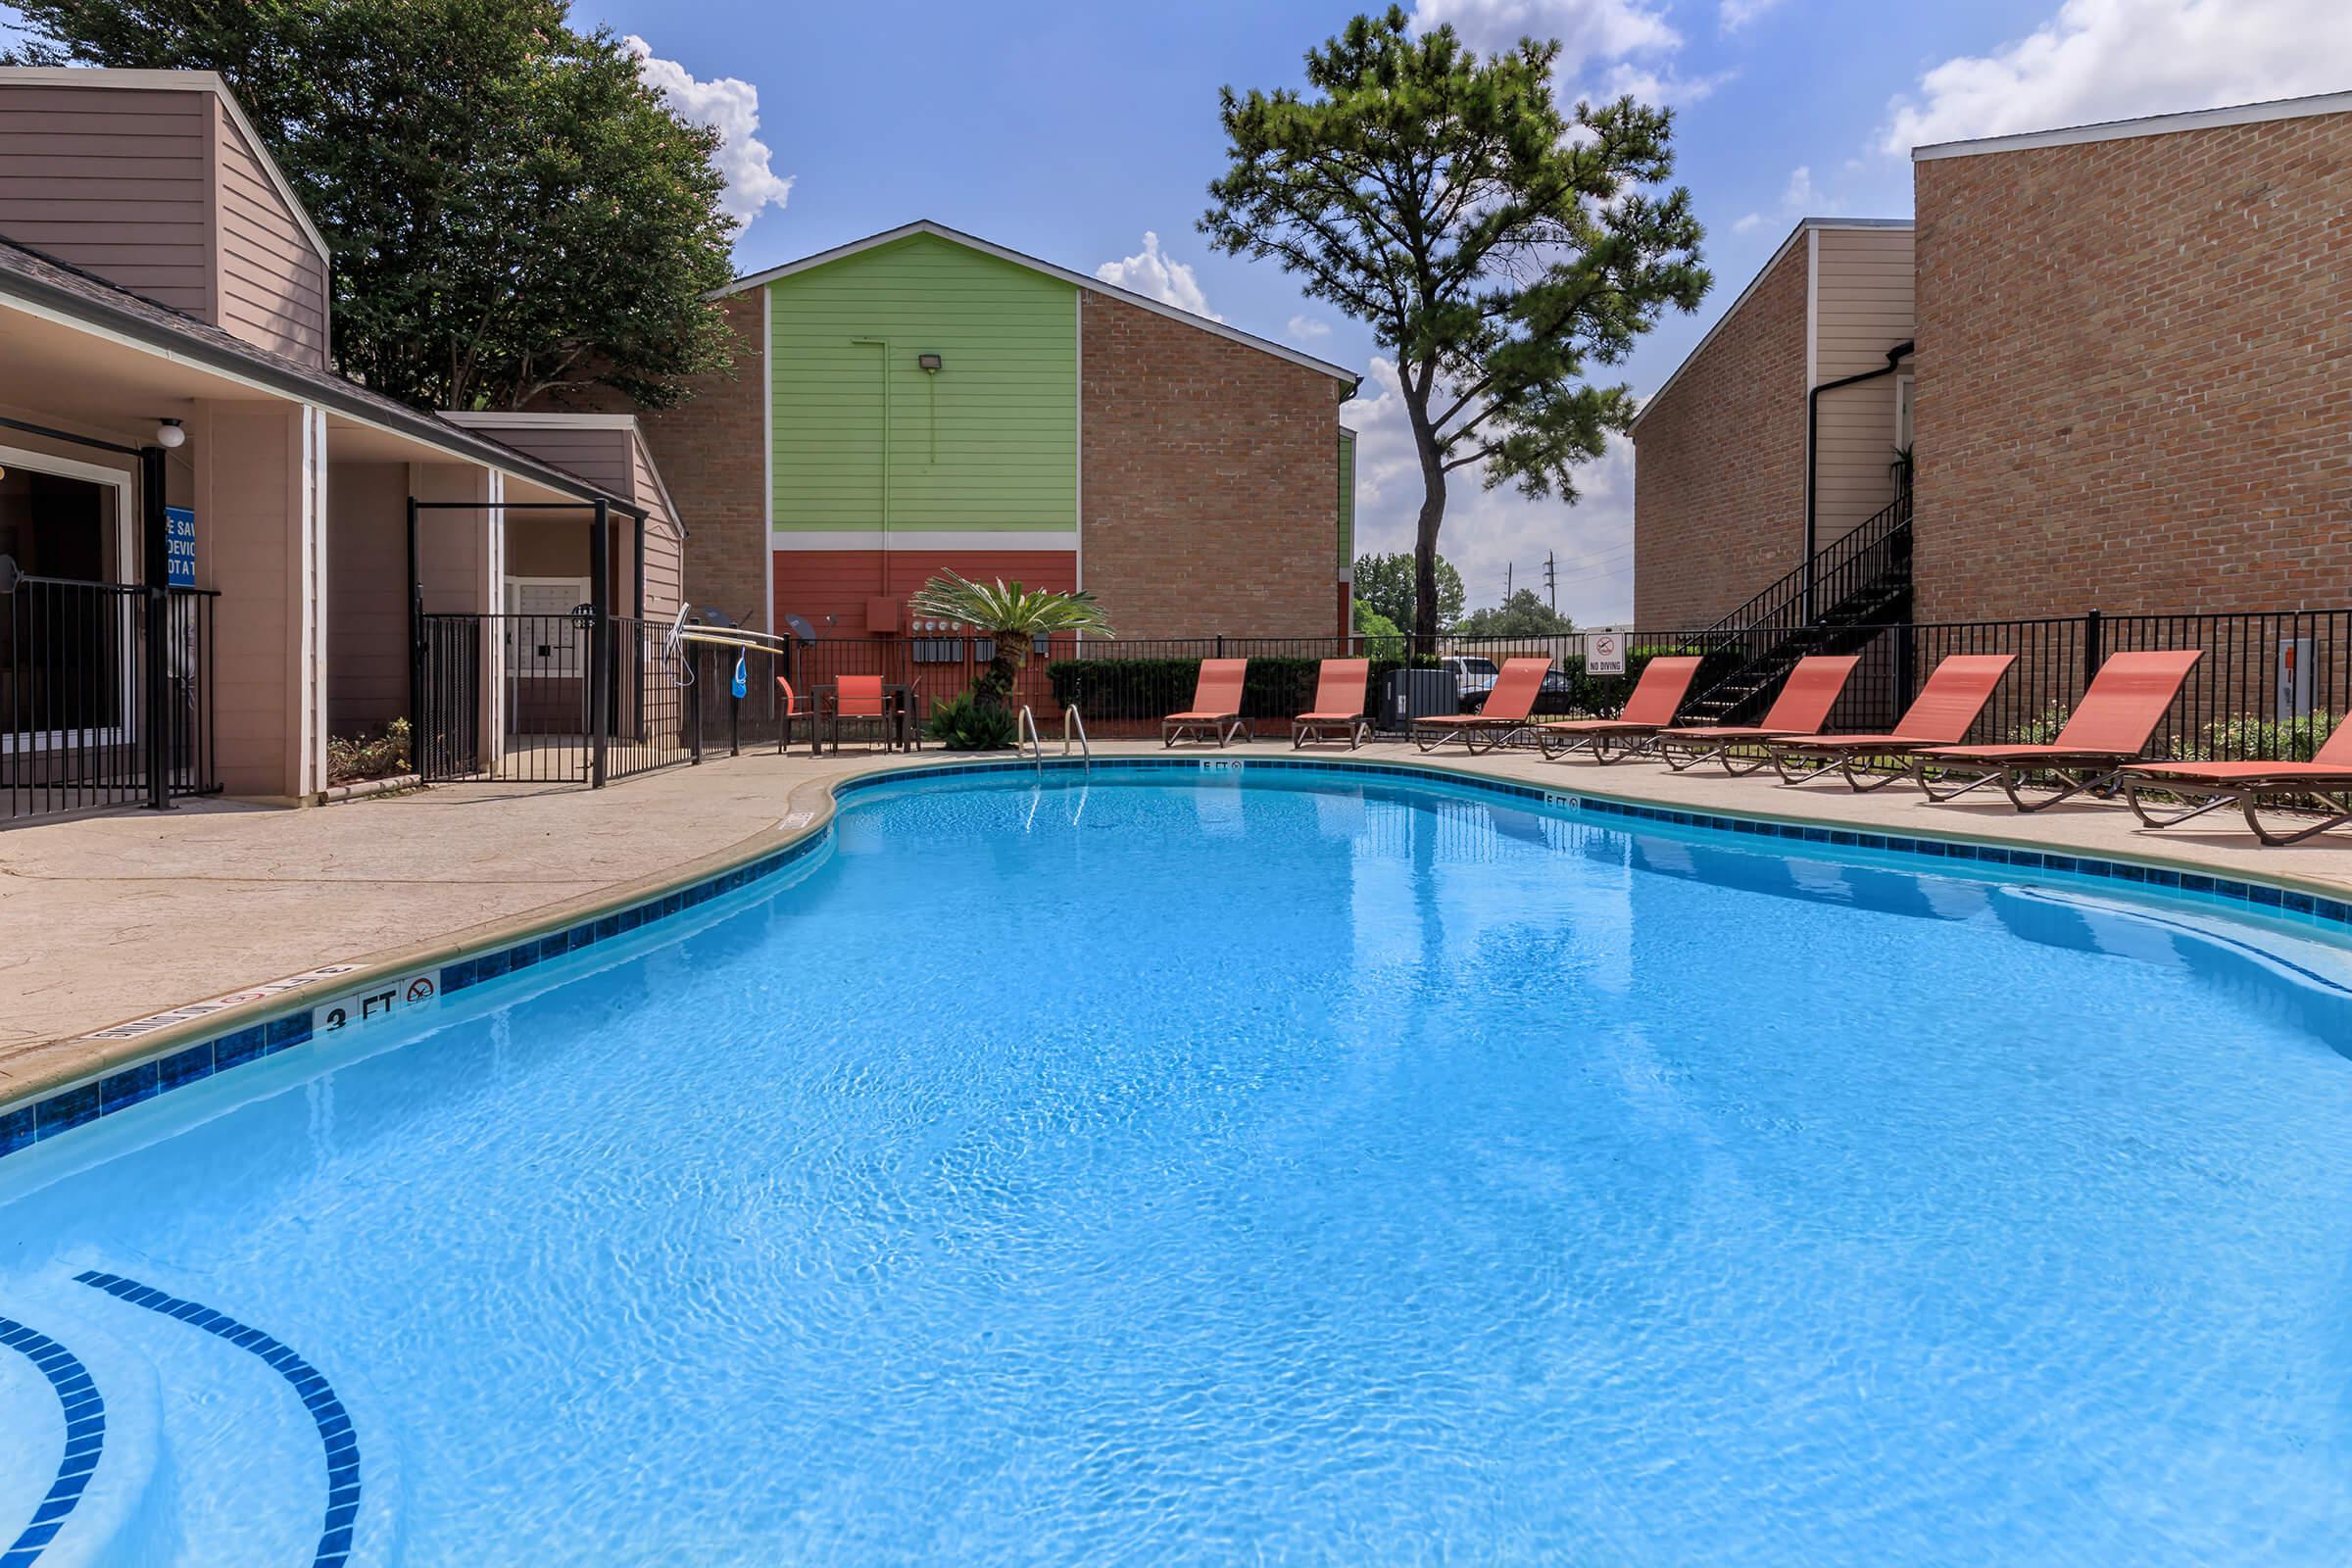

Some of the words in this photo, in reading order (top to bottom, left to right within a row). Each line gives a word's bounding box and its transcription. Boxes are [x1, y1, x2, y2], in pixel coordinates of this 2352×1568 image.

[1591, 662, 1598, 670] NO
[1600, 662, 1621, 670] DIVING
[363, 990, 396, 1019] FT
